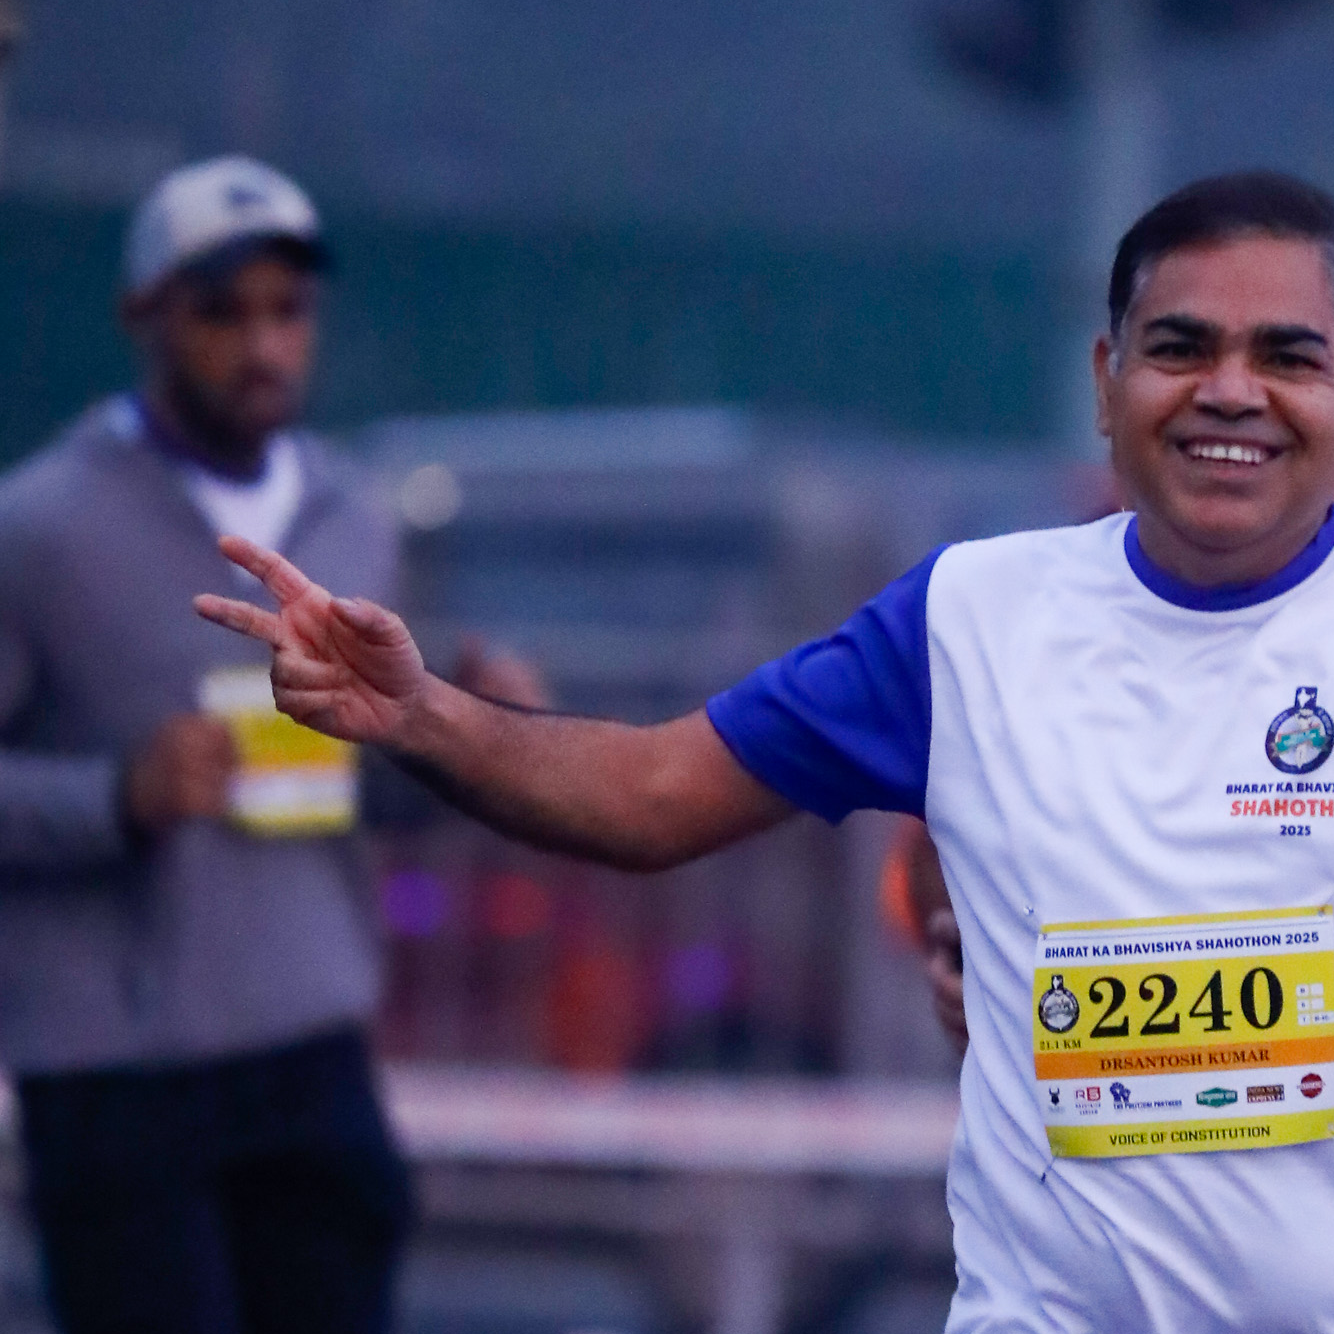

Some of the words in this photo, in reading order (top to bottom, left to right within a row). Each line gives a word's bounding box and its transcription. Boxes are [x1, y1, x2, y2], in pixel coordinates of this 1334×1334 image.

[1226, 784, 1274, 794] BHARAT
[1276, 782, 1293, 793] KA
[1280, 825, 1311, 836] 2025
[1045, 946, 1088, 958] BHARAT
[1092, 945, 1110, 956] KA
[1114, 940, 1192, 955] BHAVISHYA
[1196, 934, 1281, 950] SHAHOTHON
[1285, 932, 1319, 944] 2025
[1088, 967, 1284, 1038] 2240
[1063, 1039, 1081, 1049] KM
[1100, 1053, 1202, 1070] DRSANTOSH
[1208, 1049, 1270, 1064] KUMAR
[1109, 1133, 1148, 1146] VOICE
[1151, 1132, 1168, 1143] OF
[1171, 1126, 1270, 1142] CONSTITUTION
